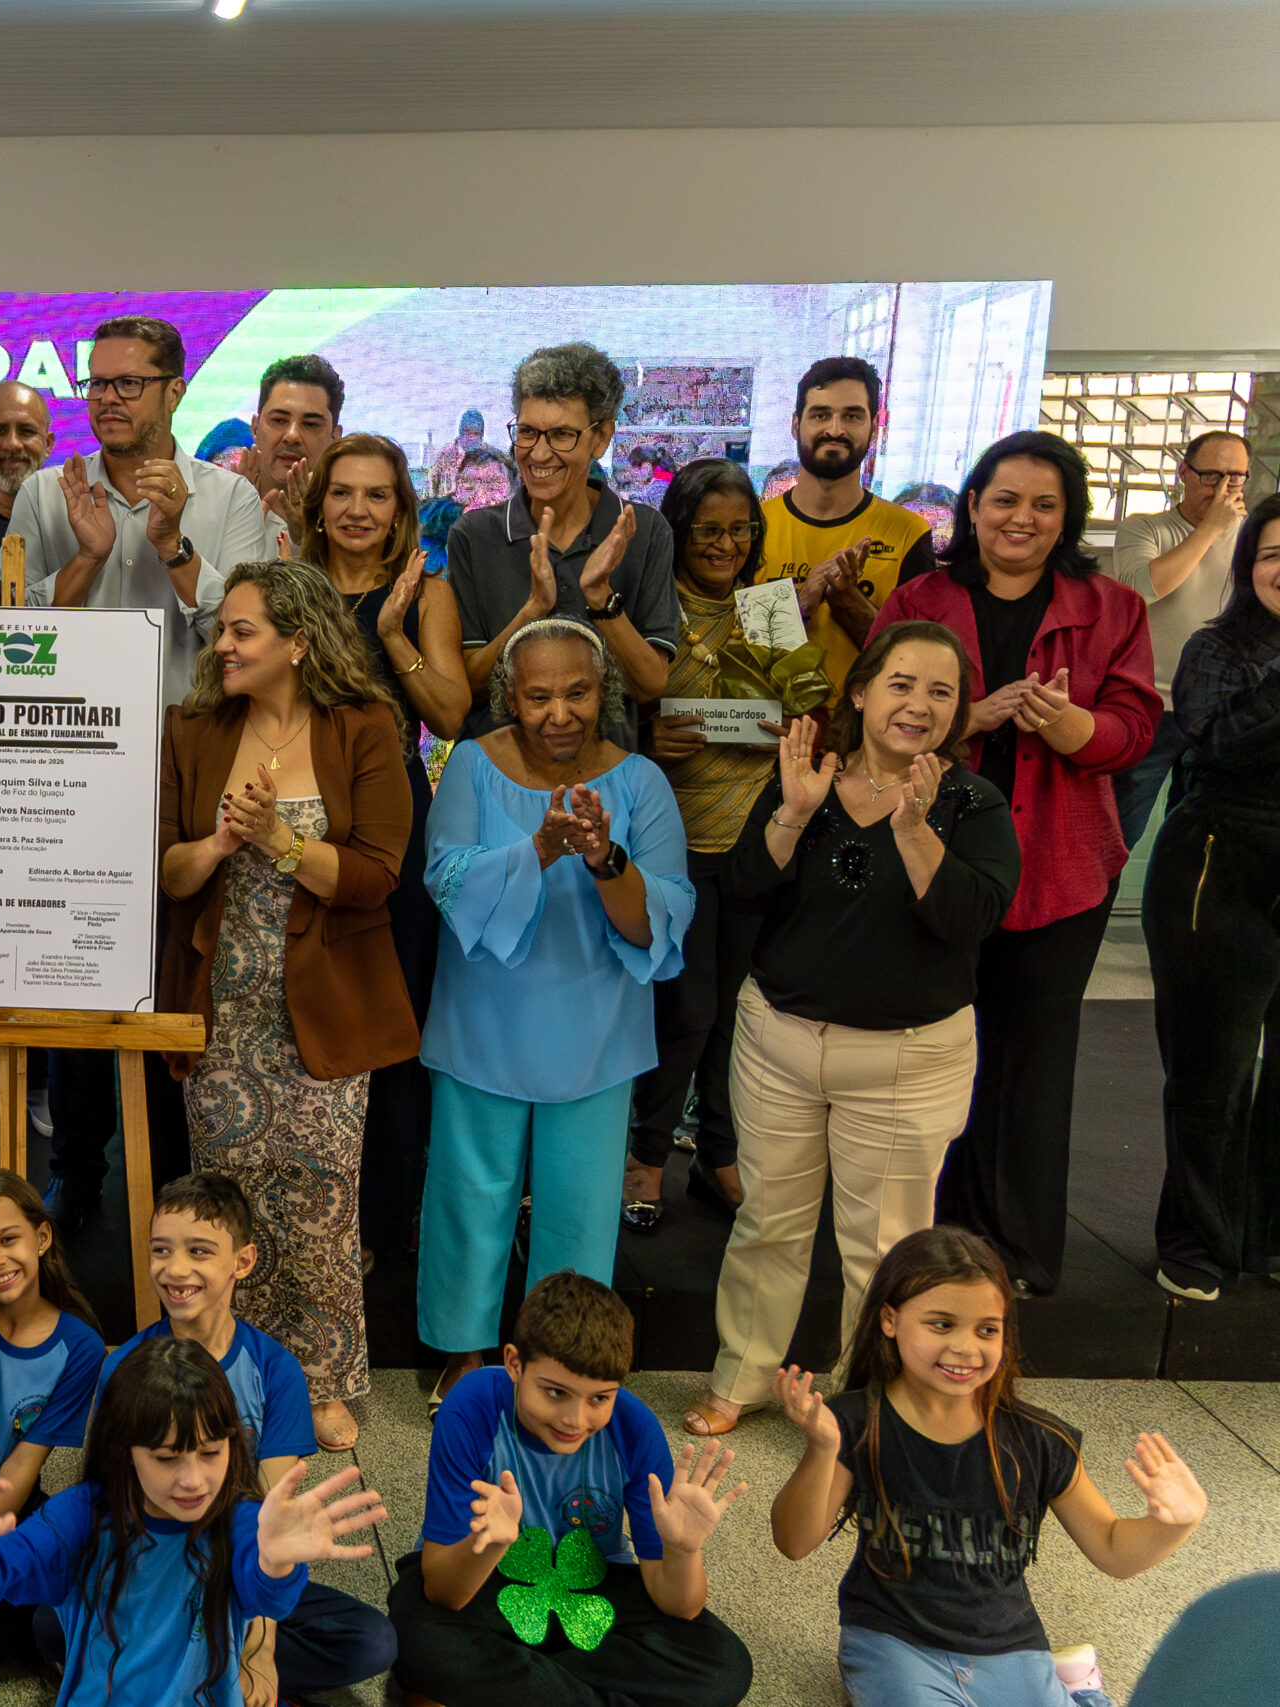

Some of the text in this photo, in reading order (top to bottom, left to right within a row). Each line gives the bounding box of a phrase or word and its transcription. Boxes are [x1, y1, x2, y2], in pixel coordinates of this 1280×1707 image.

[6, 665, 56, 679] IGUAÇU
[13, 704, 120, 727] PORTINARI
[695, 708, 728, 719] Nicolau
[729, 709, 767, 720] Cardoso
[699, 722, 741, 733] Diretora
[9, 729, 19, 737] DE
[20, 729, 49, 738] ENSINO
[51, 730, 105, 739] FUNDAMENTAL
[28, 778, 52, 787] Silva
[63, 779, 88, 788] Luna
[1, 788, 11, 796] de
[13, 788, 27, 796] Foz
[39, 789, 65, 798] Iguaçu
[19, 806, 76, 816] Nascimento
[44, 817, 67, 825] Iguaçu
[28, 867, 62, 876] Edinardo
[72, 869, 96, 877] Borba
[107, 870, 133, 879] Aguiar
[5, 898, 16, 907] DE
[17, 898, 67, 909] VEREADORES
